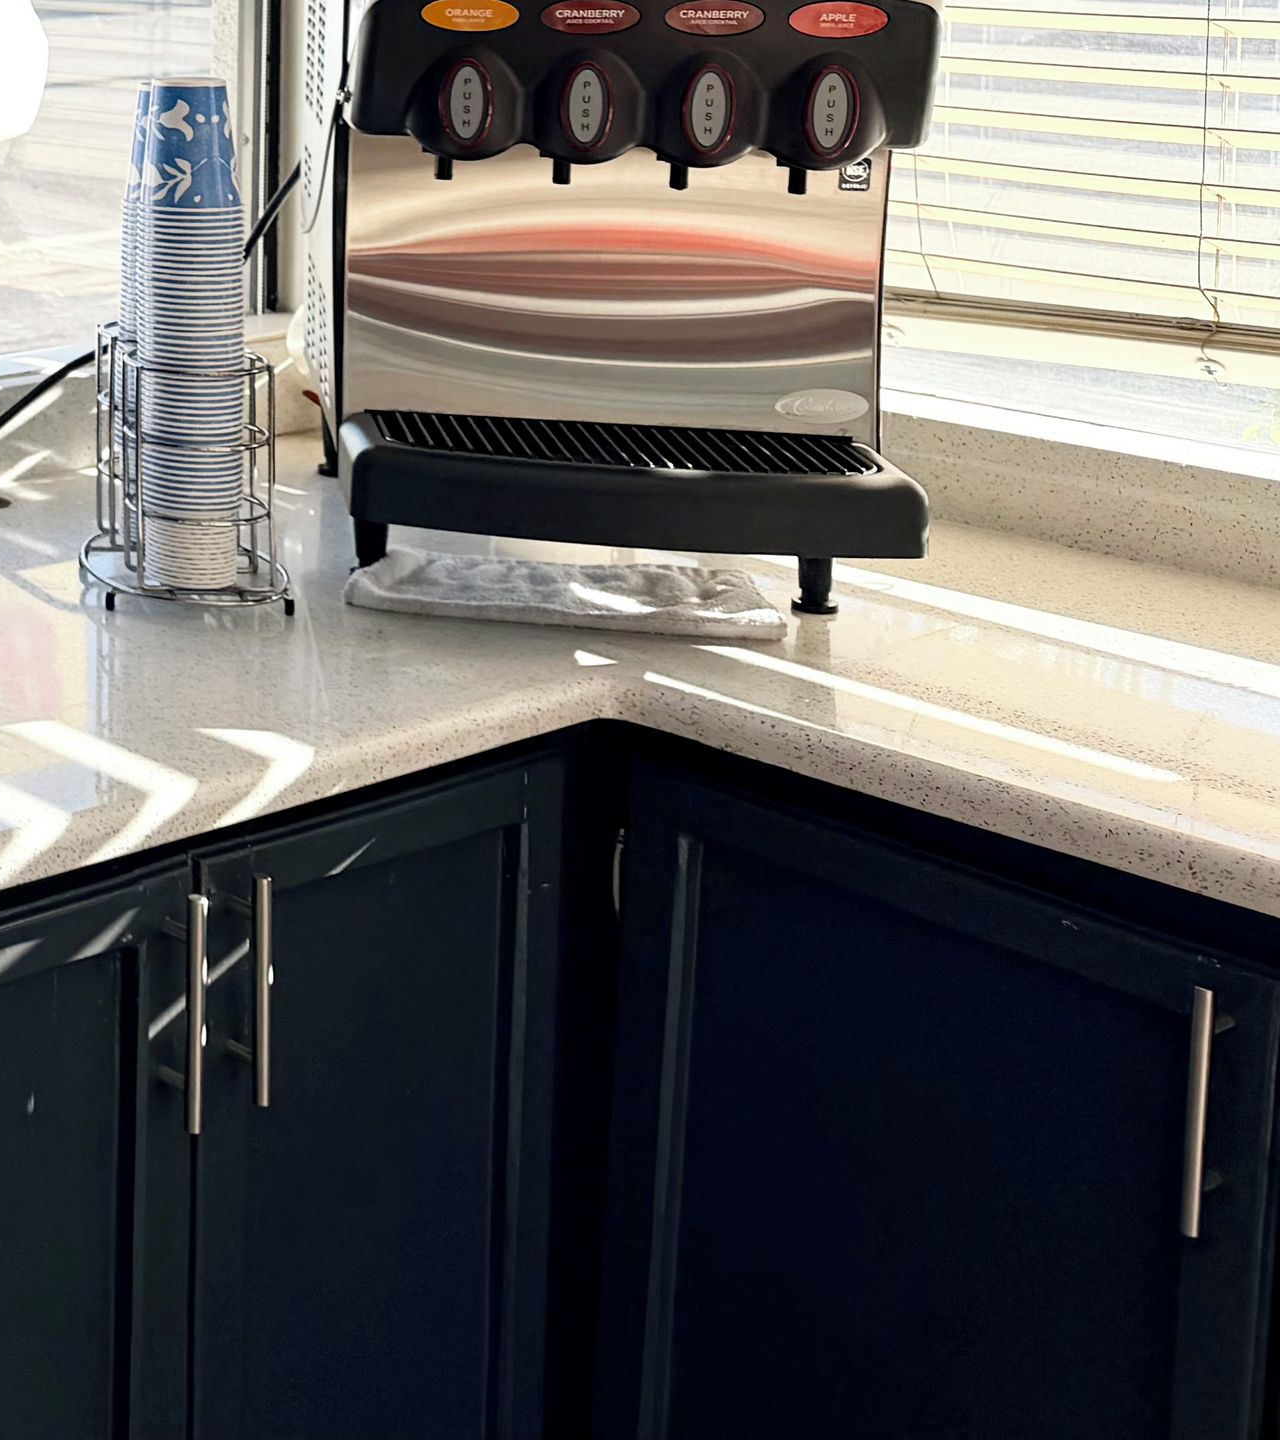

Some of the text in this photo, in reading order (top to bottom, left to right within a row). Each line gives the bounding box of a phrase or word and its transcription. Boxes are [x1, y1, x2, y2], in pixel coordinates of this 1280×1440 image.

[445, 8, 493, 18] ORANGE
[555, 9, 625, 19] CRANBERRY
[679, 9, 749, 19] CRANBERRY
[819, 13, 857, 22] APPLE
[462, 77, 473, 128] PUSH
[581, 80, 592, 132] PUSH
[703, 84, 715, 135] PUSH
[824, 85, 837, 137] PUSH
